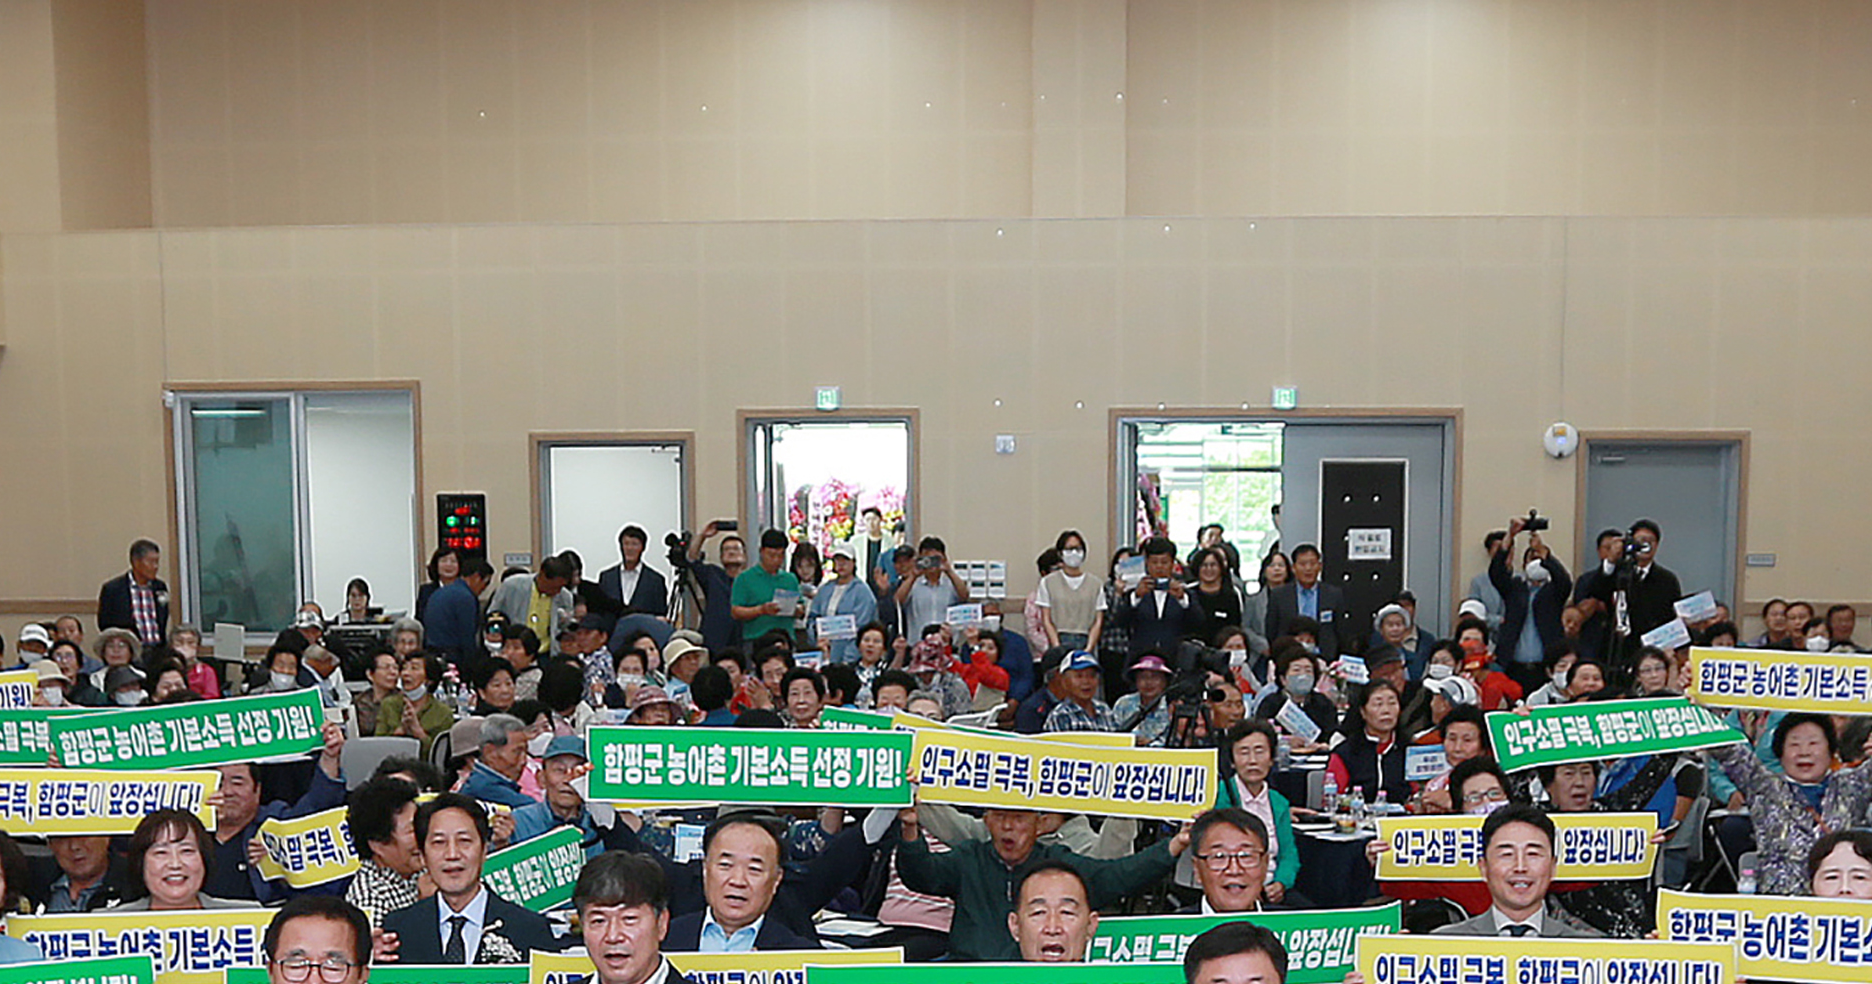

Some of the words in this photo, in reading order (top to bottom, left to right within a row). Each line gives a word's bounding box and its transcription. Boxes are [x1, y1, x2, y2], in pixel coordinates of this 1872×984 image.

[1699, 661, 1748, 695] 함평군
[1751, 663, 1800, 696] 농어촌
[1801, 665, 1868, 701] 기본소득
[58, 725, 114, 768] 함평군
[114, 720, 167, 761] 농어촌
[168, 713, 235, 754] 기본소득
[237, 709, 272, 743] 선정
[276, 703, 316, 739] 기원!
[1504, 716, 1564, 757] 인구소멸
[1564, 714, 1601, 749] 극복,
[1595, 709, 1657, 745] 함평군이
[603, 743, 663, 784] 함평군
[668, 744, 726, 785] 농어촌
[729, 747, 809, 787] 기본소득
[812, 747, 852, 787] 선정
[856, 747, 903, 789] 기원!
[921, 749, 993, 792] 인구소멸
[995, 753, 1034, 799] 극복,
[1039, 759, 1113, 798] 함평군이
[1114, 760, 1205, 804] 앞장섭니다!
[38, 781, 106, 816] 함평군이
[108, 782, 203, 816] 앞장섭니다!
[304, 826, 346, 868] 극복,
[1394, 828, 1457, 867] 인구소멸
[1563, 828, 1646, 866] 앞장섭니다!
[167, 927, 256, 972] 기본소득
[1742, 911, 1812, 959] 농어촌
